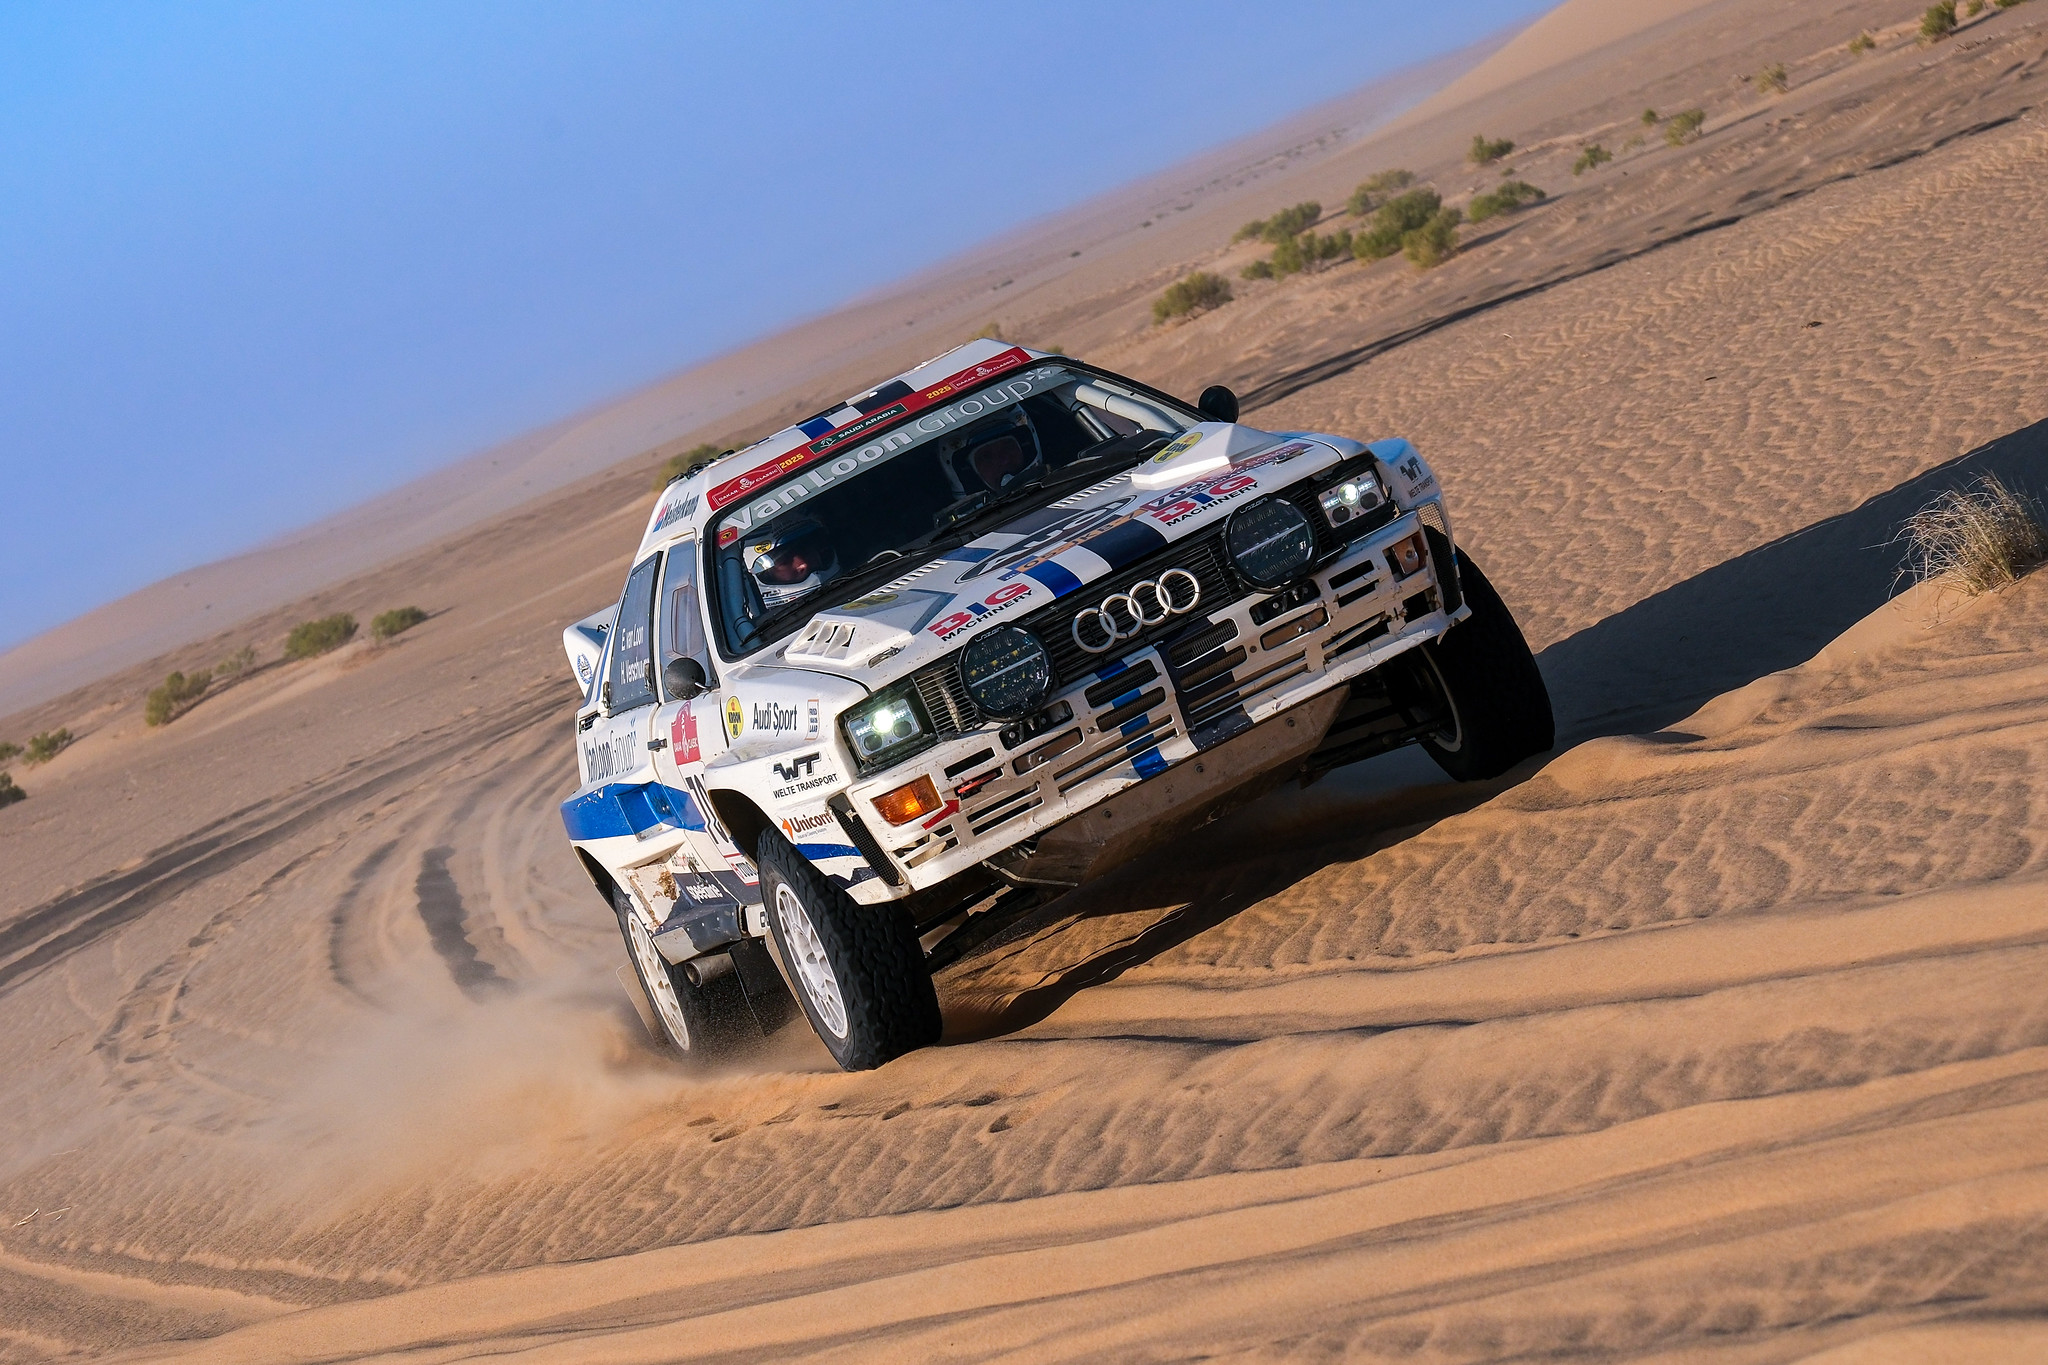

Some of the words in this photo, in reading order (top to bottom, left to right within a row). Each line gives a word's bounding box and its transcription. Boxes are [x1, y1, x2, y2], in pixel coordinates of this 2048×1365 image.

[956, 375, 976, 388] DAKAR
[992, 358, 1016, 372] CLASSIC
[926, 384, 952, 400] 2025
[837, 423, 865, 439] SAUDI
[865, 408, 898, 427] ARABIA
[778, 452, 805, 470] 2025
[718, 488, 739, 502] DAKAR
[755, 468, 779, 483] CLASSIC
[1150, 475, 1257, 523] BIG
[1165, 481, 1259, 527] MACHINERY
[927, 582, 1031, 638] BIG
[941, 589, 1033, 642] MACHINERY
[752, 702, 772, 730] Audi
[773, 701, 798, 737] Sport
[773, 751, 821, 782] WT
[773, 785, 796, 799] WELTE
[796, 773, 839, 792] TRANSPORT
[685, 773, 730, 845] 70
[789, 811, 834, 833] Unicorn
